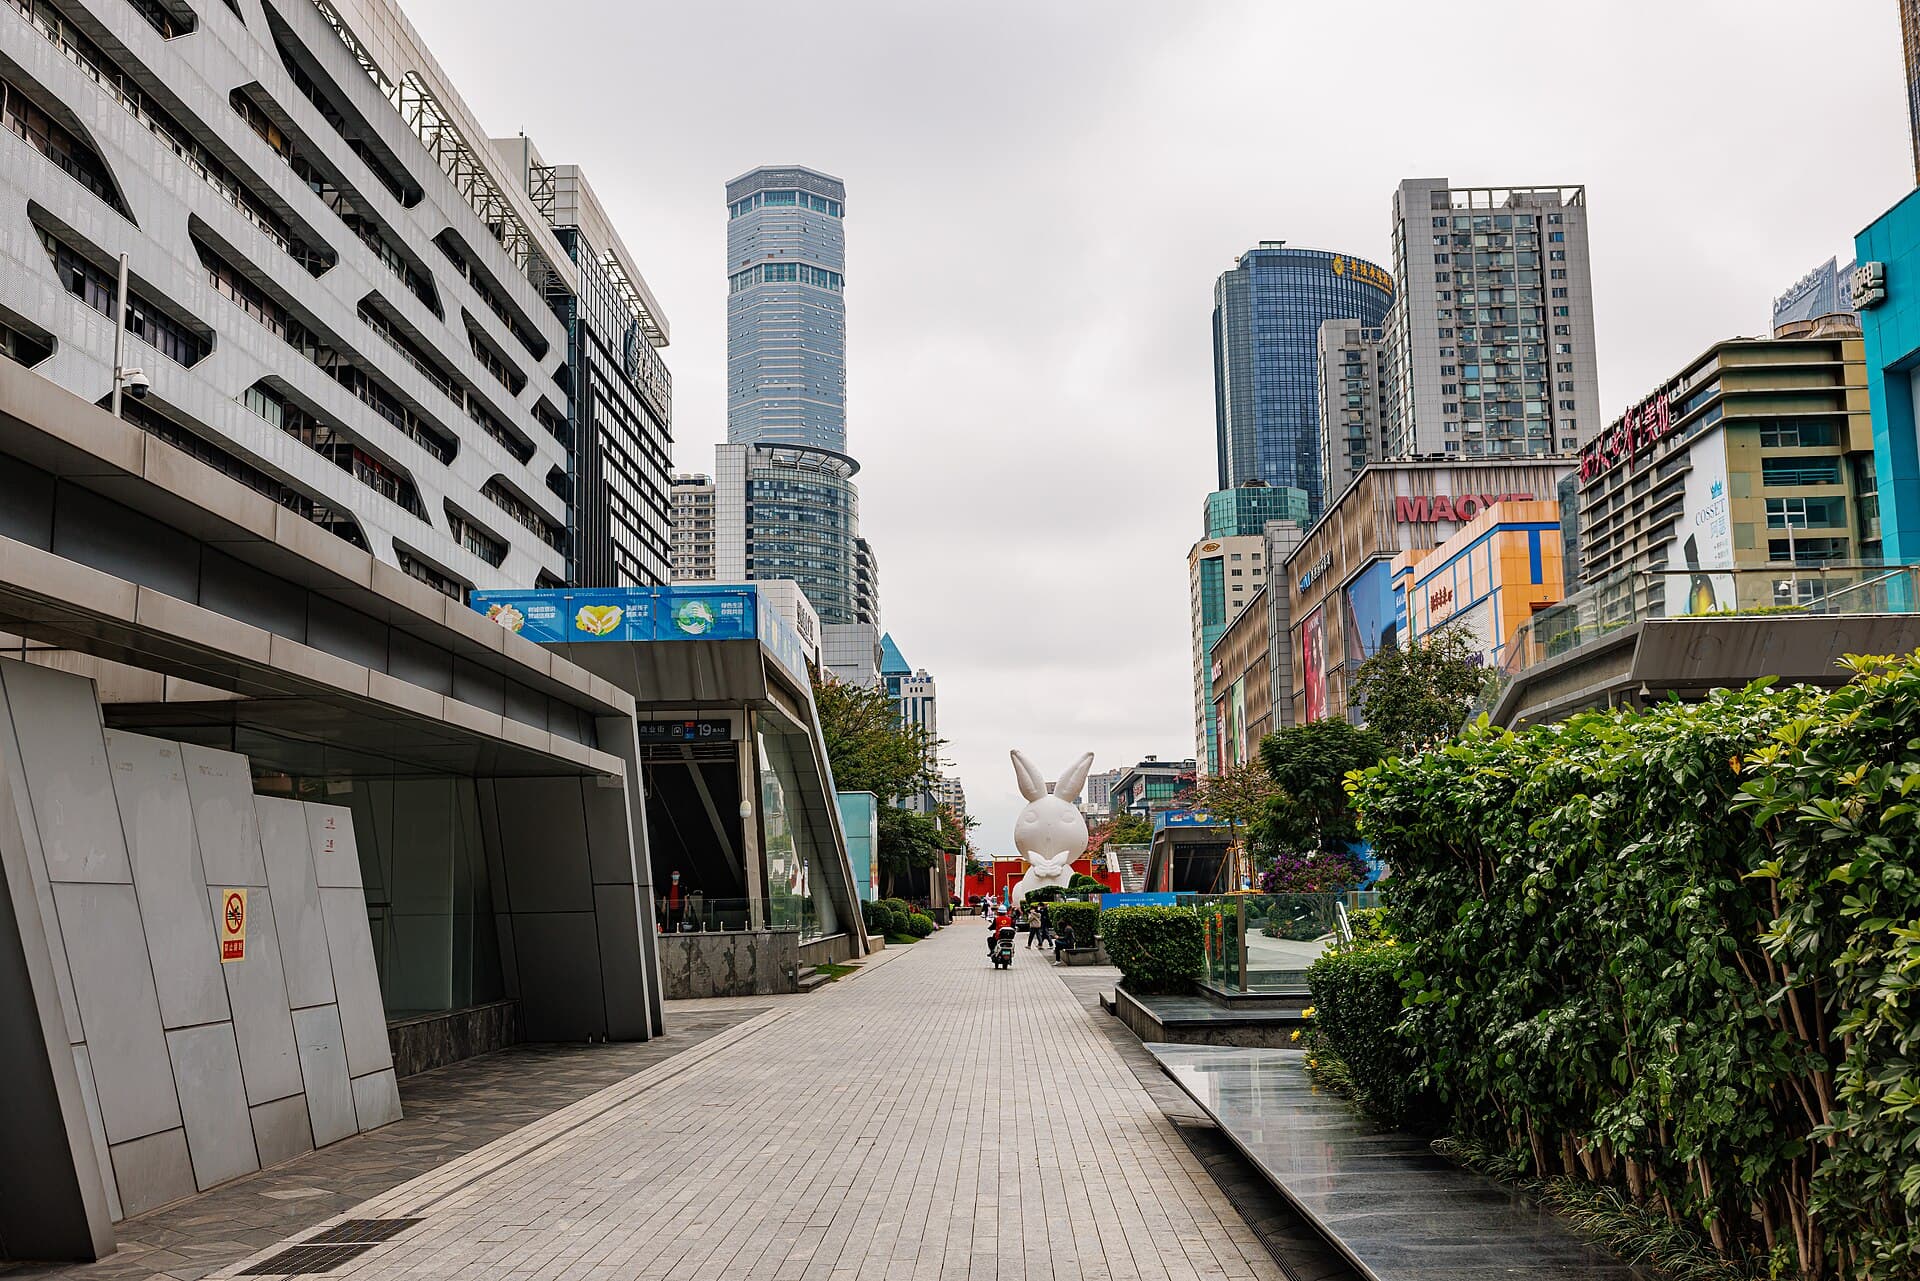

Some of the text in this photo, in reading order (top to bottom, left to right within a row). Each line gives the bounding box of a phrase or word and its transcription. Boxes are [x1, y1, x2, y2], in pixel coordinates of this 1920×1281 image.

[1395, 493, 1534, 523] MAO
[1695, 497, 1726, 526] COSSET
[697, 724, 712, 736] 19
